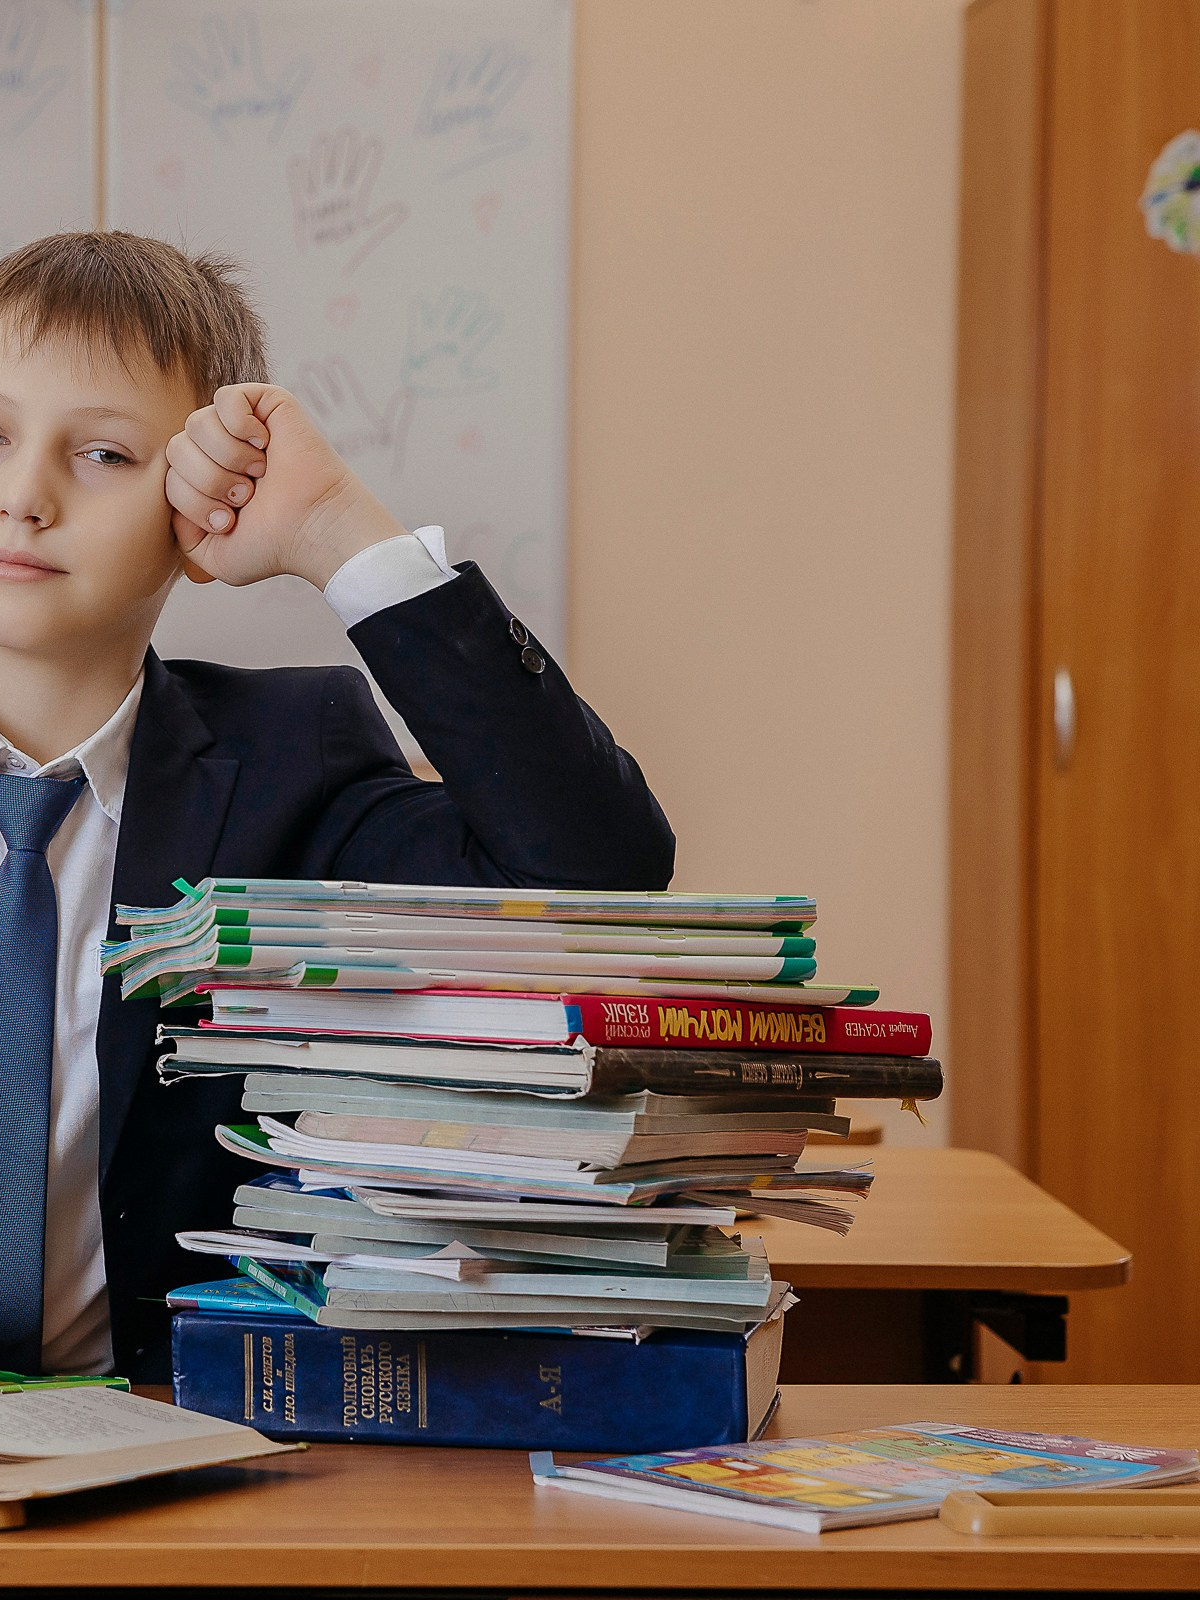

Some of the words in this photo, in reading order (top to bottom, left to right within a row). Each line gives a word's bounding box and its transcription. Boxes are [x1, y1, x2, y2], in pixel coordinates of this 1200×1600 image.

[600, 1002, 650, 1024] ЯЗЫК
[657, 1005, 743, 1042] МОГУЧИЙ
[748, 1009, 826, 1046] ВЕЛИКИЙ
[845, 1022, 887, 1038] УСАЧЕВ
[889, 1021, 919, 1038] Андрей
[605, 1024, 650, 1041] РУССКИЙ
[262, 1336, 273, 1386] ОЖЕГОВ
[284, 1333, 296, 1392] ШВЕДОВА
[340, 1336, 358, 1427] ТОЛКОВЫЙ
[360, 1344, 375, 1419] СЛОВАРЬ
[378, 1341, 394, 1425] РУССКОГО
[396, 1353, 411, 1414] ЯЗЫКА
[262, 1388, 274, 1413] С.И.
[285, 1393, 296, 1424] Н.Ю.
